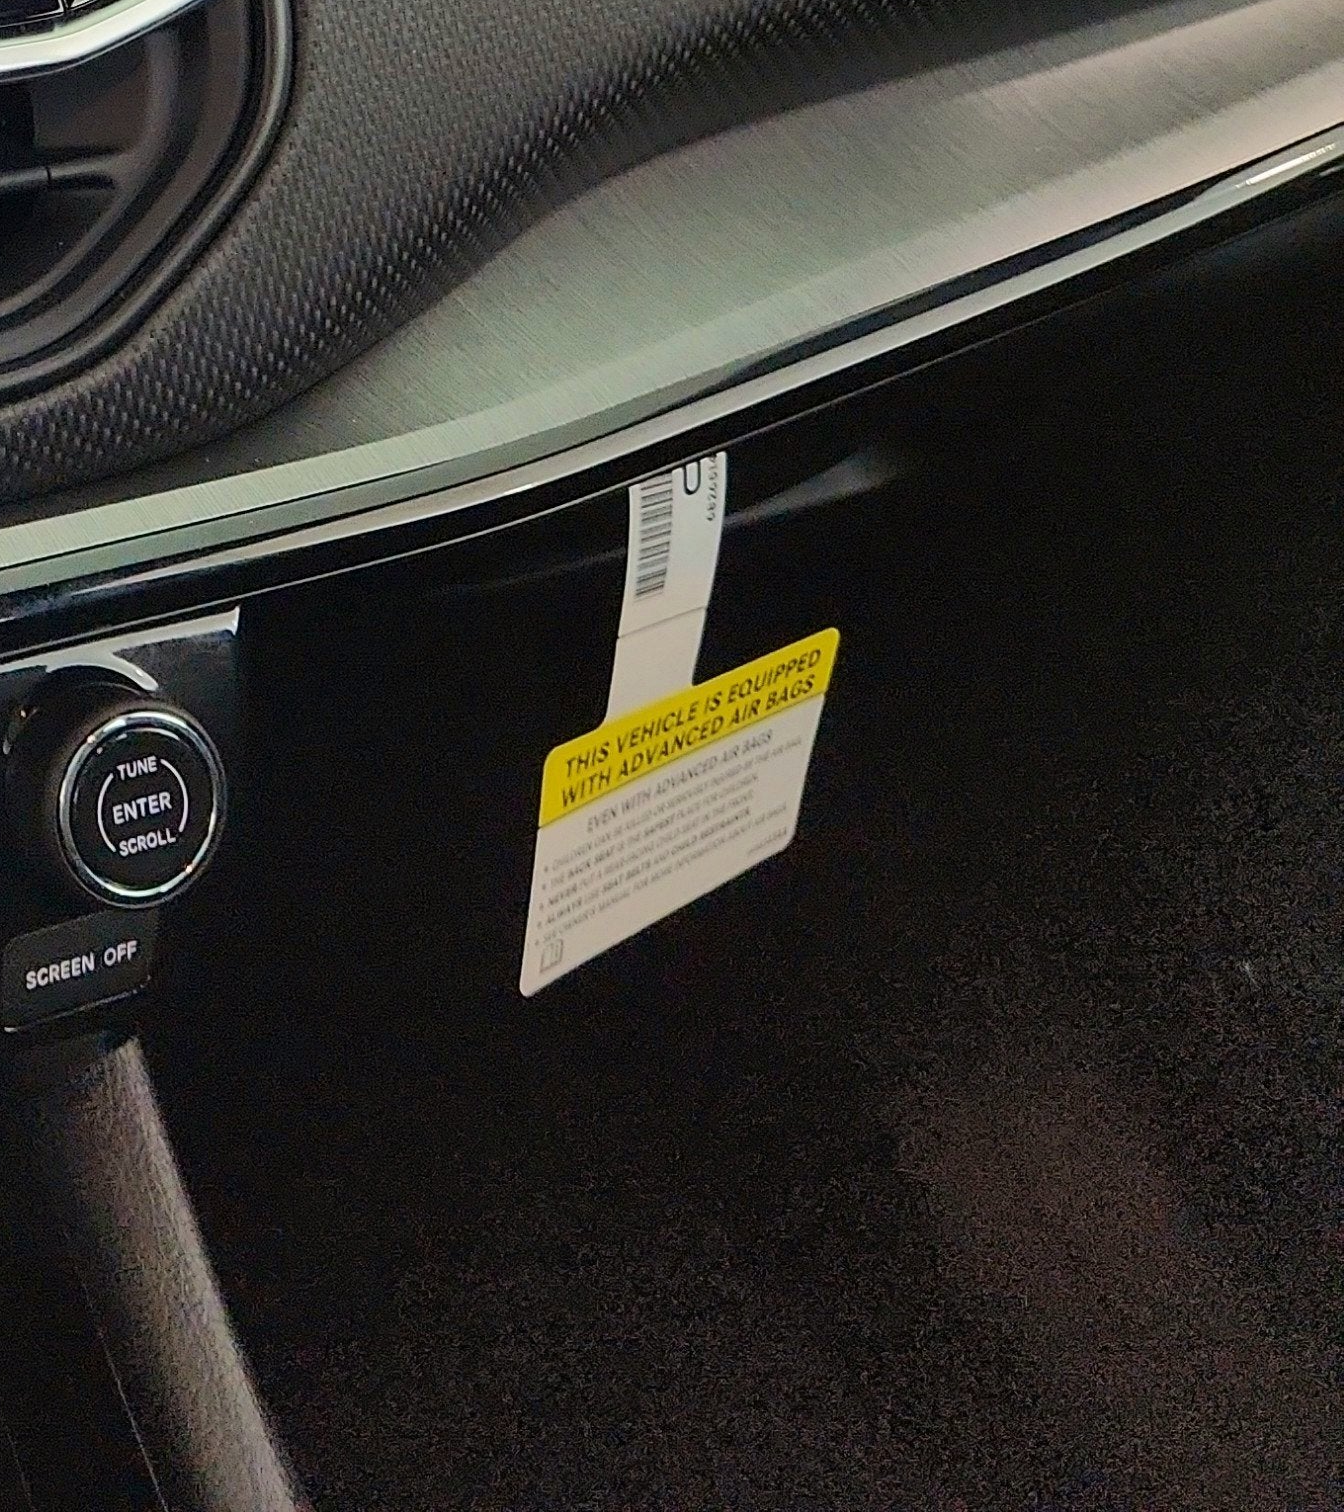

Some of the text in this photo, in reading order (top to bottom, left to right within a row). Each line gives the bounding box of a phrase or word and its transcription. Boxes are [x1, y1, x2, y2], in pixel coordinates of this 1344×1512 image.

[565, 648, 822, 777] THIS VEHICLE IS EQUIPPED
[561, 673, 816, 808] WITH ADVANCED AIR BAGS
[116, 755, 158, 782] TUNE
[112, 791, 172, 825] ENTER
[118, 828, 176, 858] SCROLL
[26, 940, 138, 990] SCREEN OFF
